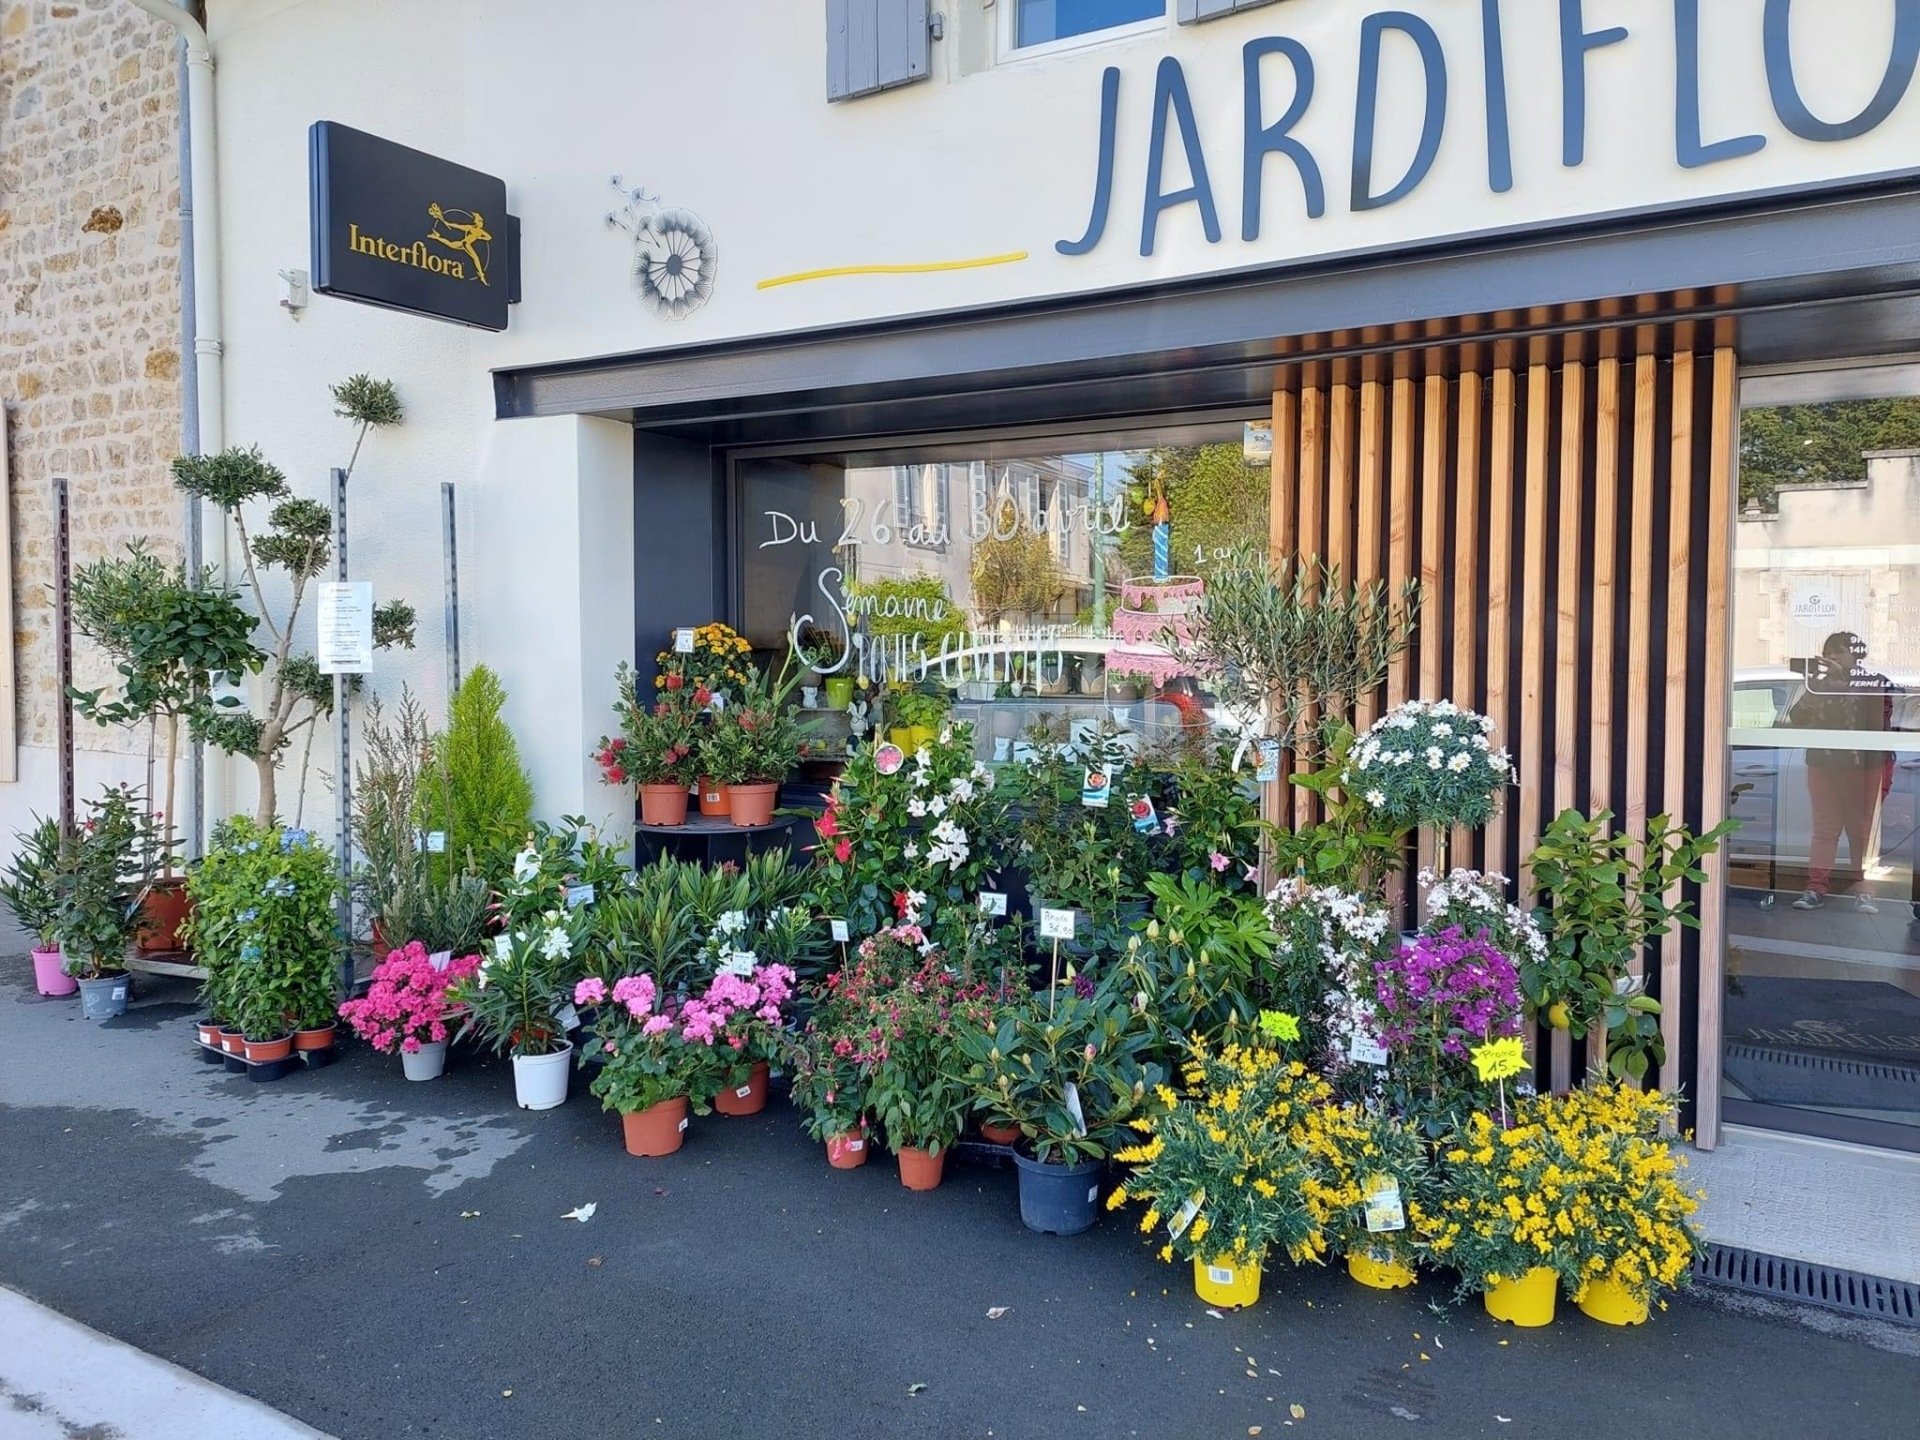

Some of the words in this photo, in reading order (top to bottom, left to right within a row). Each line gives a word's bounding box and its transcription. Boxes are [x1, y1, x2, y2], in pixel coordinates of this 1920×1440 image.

[347, 222, 465, 280] Interflora
[758, 510, 822, 549] Du
[838, 497, 893, 546] 26
[908, 522, 952, 546] au
[960, 490, 1020, 544] 30
[1032, 494, 1131, 535] avril
[794, 566, 948, 674] Semaine
[852, 630, 928, 684] PORTES
[1479, 1049, 1517, 1060] Promo
